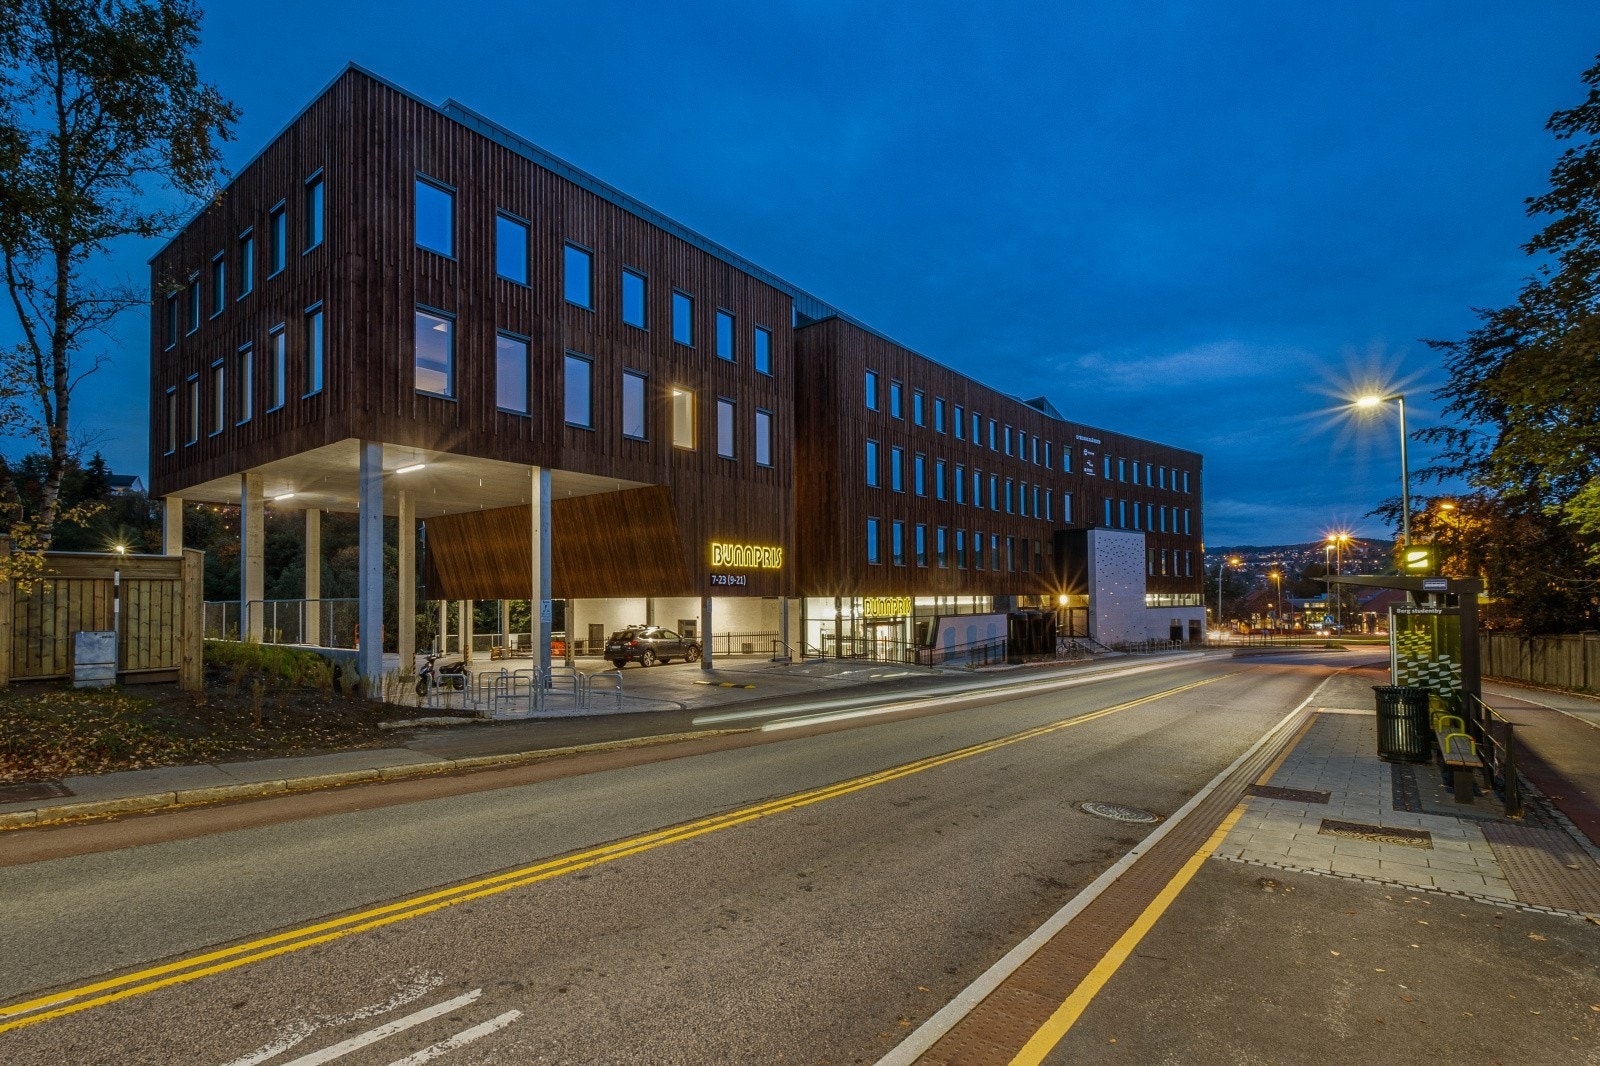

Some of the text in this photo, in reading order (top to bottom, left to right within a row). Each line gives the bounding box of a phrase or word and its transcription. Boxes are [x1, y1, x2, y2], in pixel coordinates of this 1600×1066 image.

[712, 543, 782, 568] BUNNPRIS
[712, 574, 746, 586] 7-23 (9-21)
